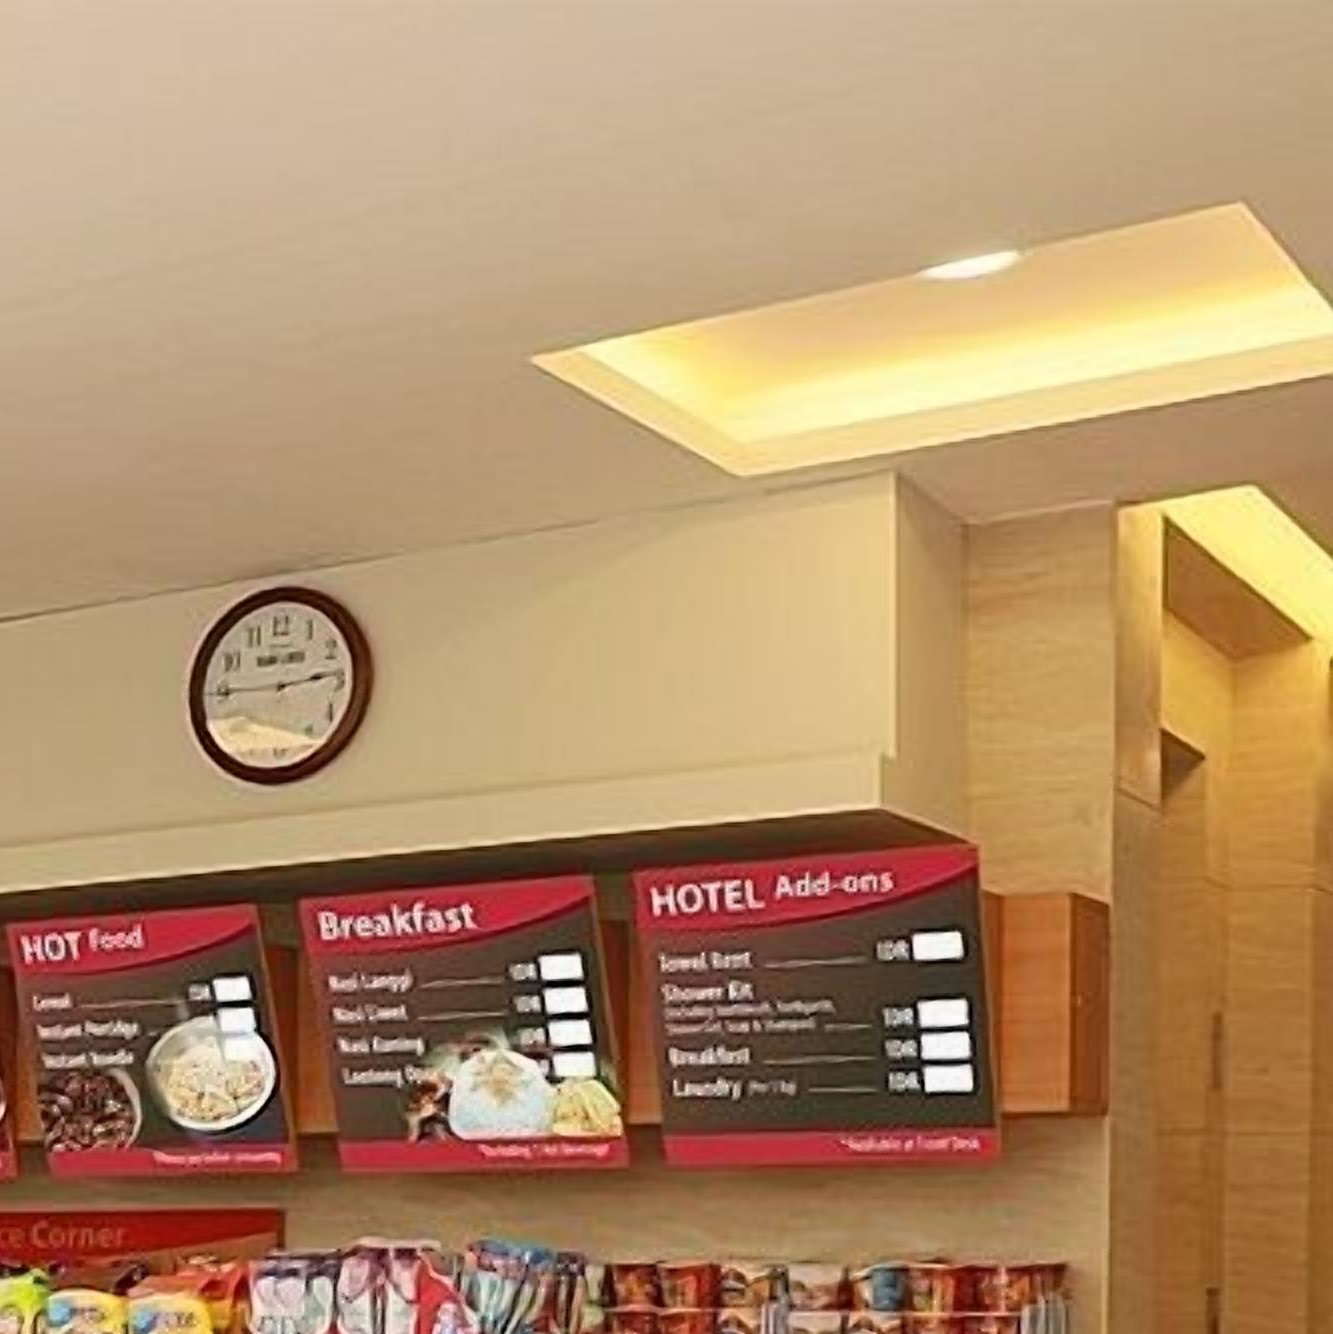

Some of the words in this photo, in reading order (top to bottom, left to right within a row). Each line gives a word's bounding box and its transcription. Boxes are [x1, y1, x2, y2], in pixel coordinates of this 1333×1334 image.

[650, 877, 766, 917] HOTEL
[774, 870, 894, 900] Add-ons
[317, 901, 480, 942] Breakfast
[20, 930, 83, 966] HOT
[32, 1220, 128, 1249] Corner
